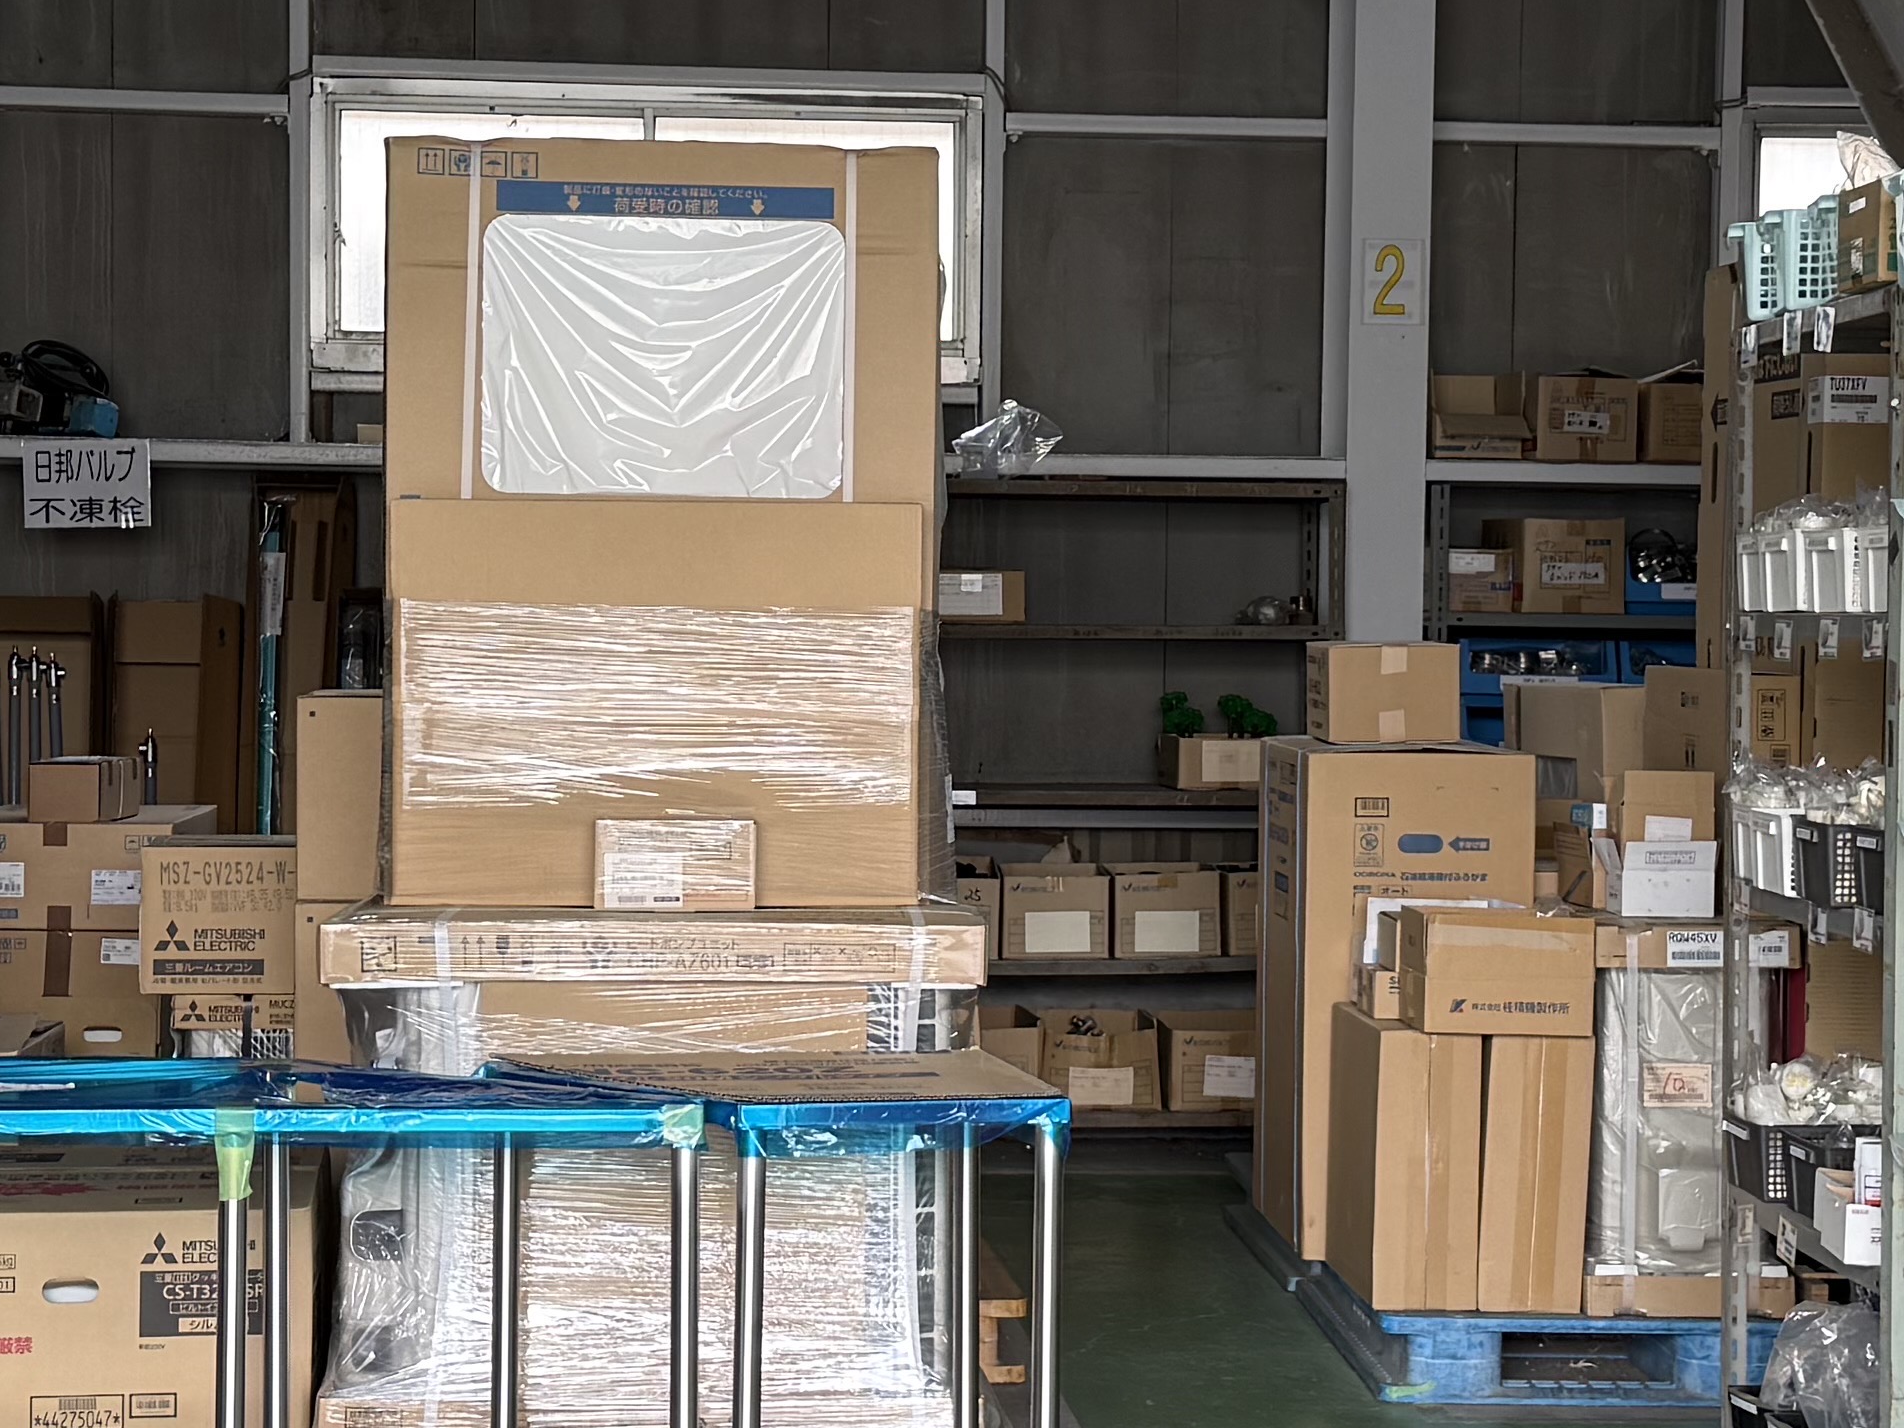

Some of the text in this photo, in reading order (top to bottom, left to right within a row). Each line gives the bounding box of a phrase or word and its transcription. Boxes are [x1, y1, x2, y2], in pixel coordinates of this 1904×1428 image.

[614, 197, 719, 215] 荷受時の確認
[1373, 244, 1406, 315] 2
[29, 496, 144, 523] 不凍栓
[194, 929, 265, 939] MITSUBISHI
[194, 940, 256, 951] ELECTRIC
